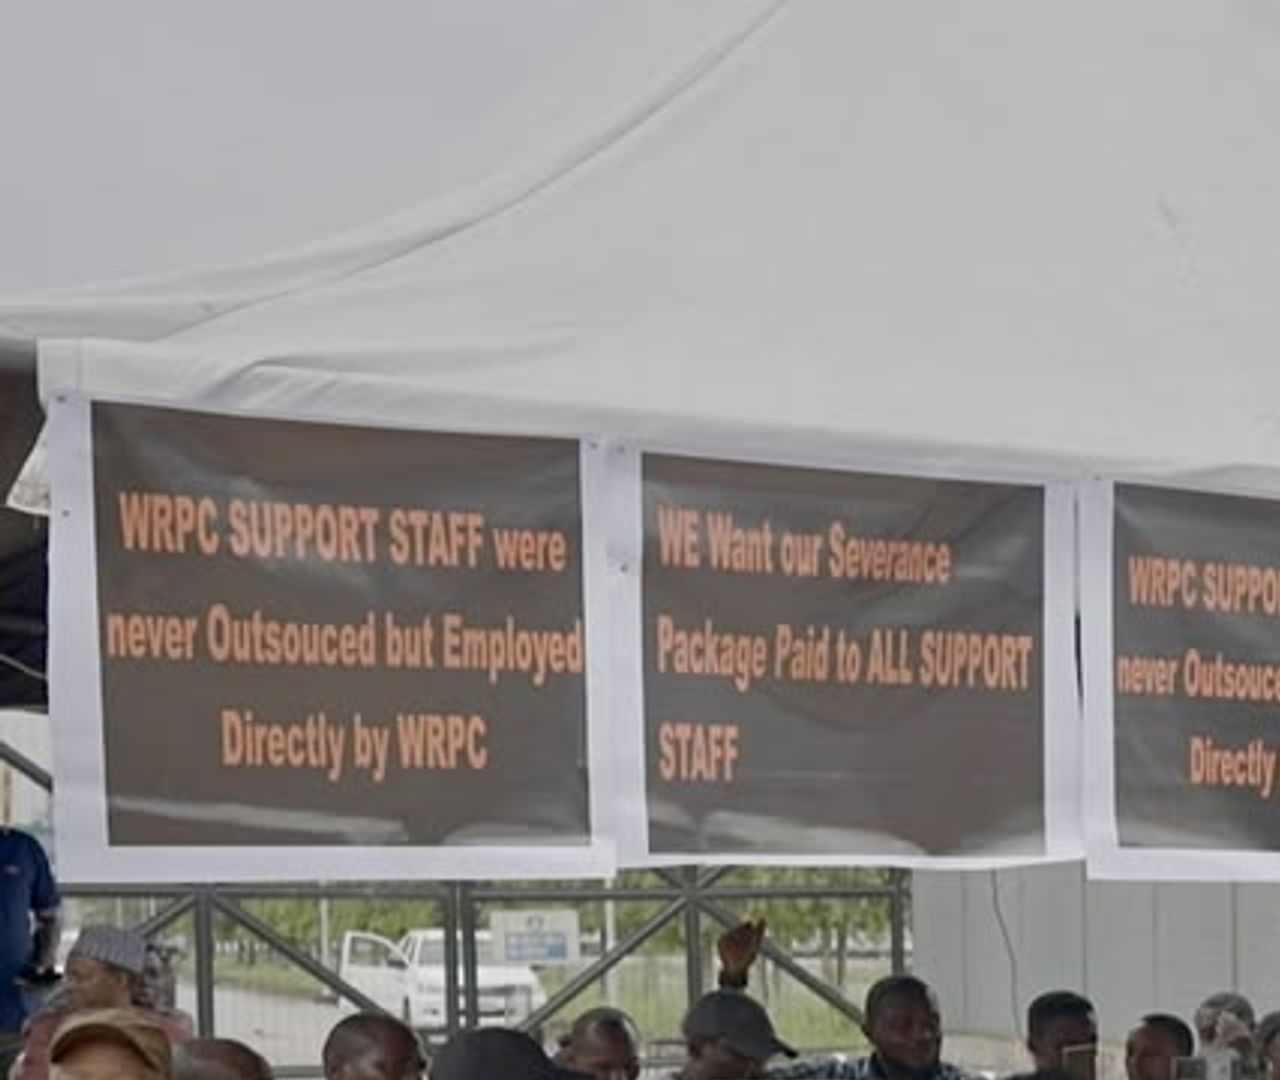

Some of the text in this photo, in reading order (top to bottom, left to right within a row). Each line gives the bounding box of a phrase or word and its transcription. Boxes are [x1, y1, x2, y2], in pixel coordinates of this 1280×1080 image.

[119, 493, 567, 571] WRPC SUPPORT STAFF were
[659, 507, 950, 583] WE Want our Severance
[1129, 557, 1198, 607] WRPC
[107, 603, 584, 684] never Outsouced but Employed
[658, 615, 1033, 691] Package Paid to ALL SUPPORT
[1117, 656, 1177, 696] never
[221, 710, 489, 781] Directly by WRPC
[659, 723, 739, 781] STAFF
[1190, 737, 1277, 798] Directly
